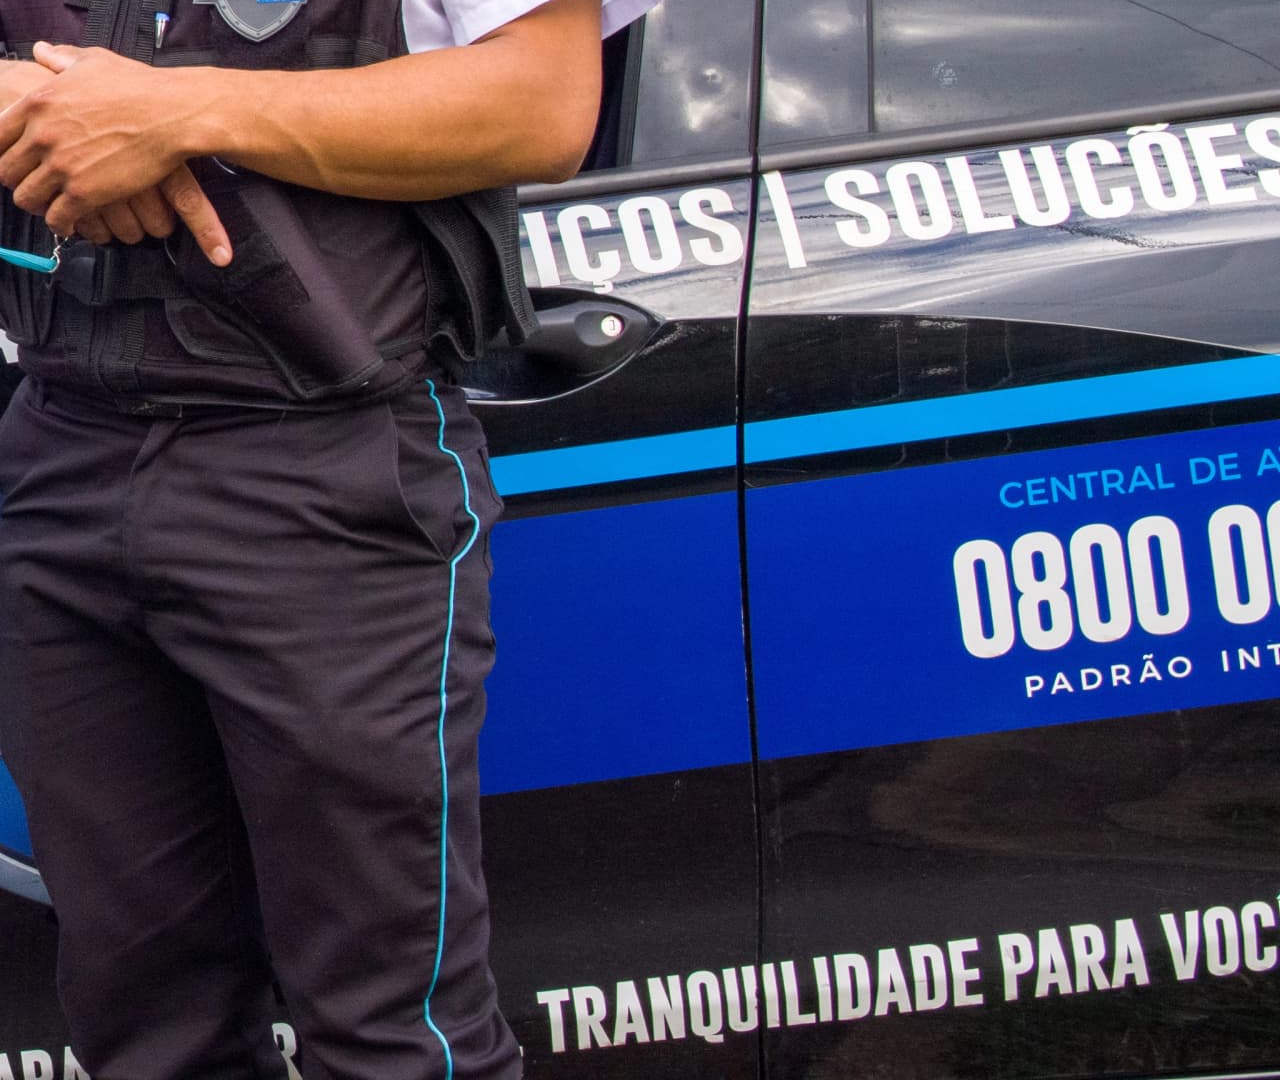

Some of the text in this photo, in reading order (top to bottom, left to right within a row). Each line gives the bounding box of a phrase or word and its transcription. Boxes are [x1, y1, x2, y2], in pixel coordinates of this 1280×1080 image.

[999, 446, 1280, 509] CENTRAL DE A
[952, 500, 1280, 659] 0800 0
[1024, 652, 1192, 699] PADRÃO
[536, 894, 1280, 1053] TRANQUILIDADE PARA VOC
